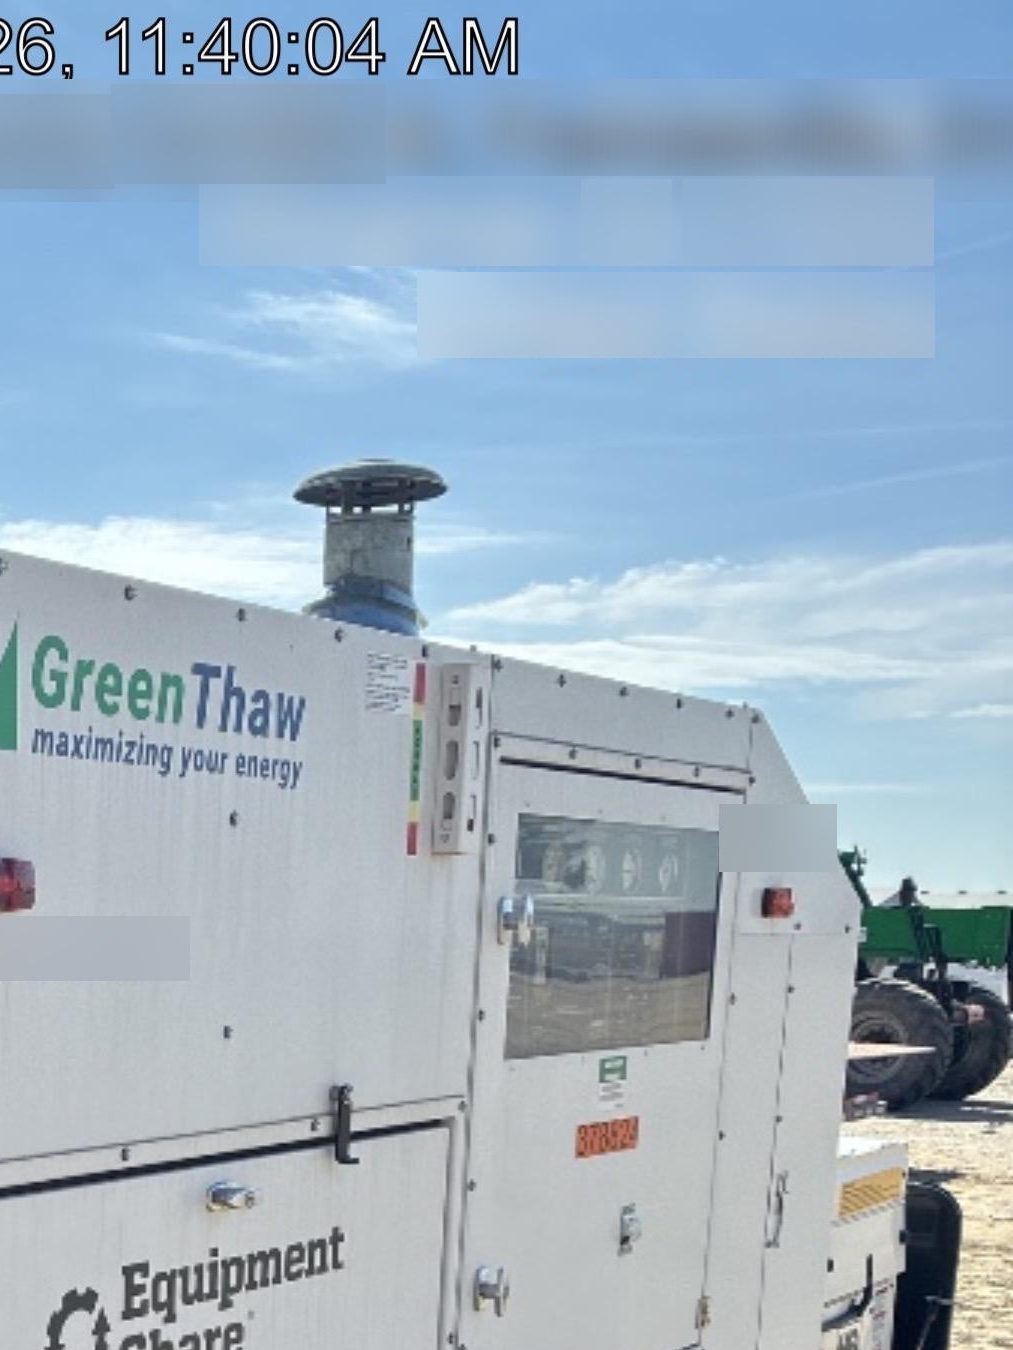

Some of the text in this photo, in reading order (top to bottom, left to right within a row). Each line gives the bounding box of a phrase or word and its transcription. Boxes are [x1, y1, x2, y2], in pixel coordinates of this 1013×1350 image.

[31, 634, 306, 742] GreenThaw
[31, 726, 304, 790] maximizing your energy
[121, 1226, 345, 1323] Equipment
